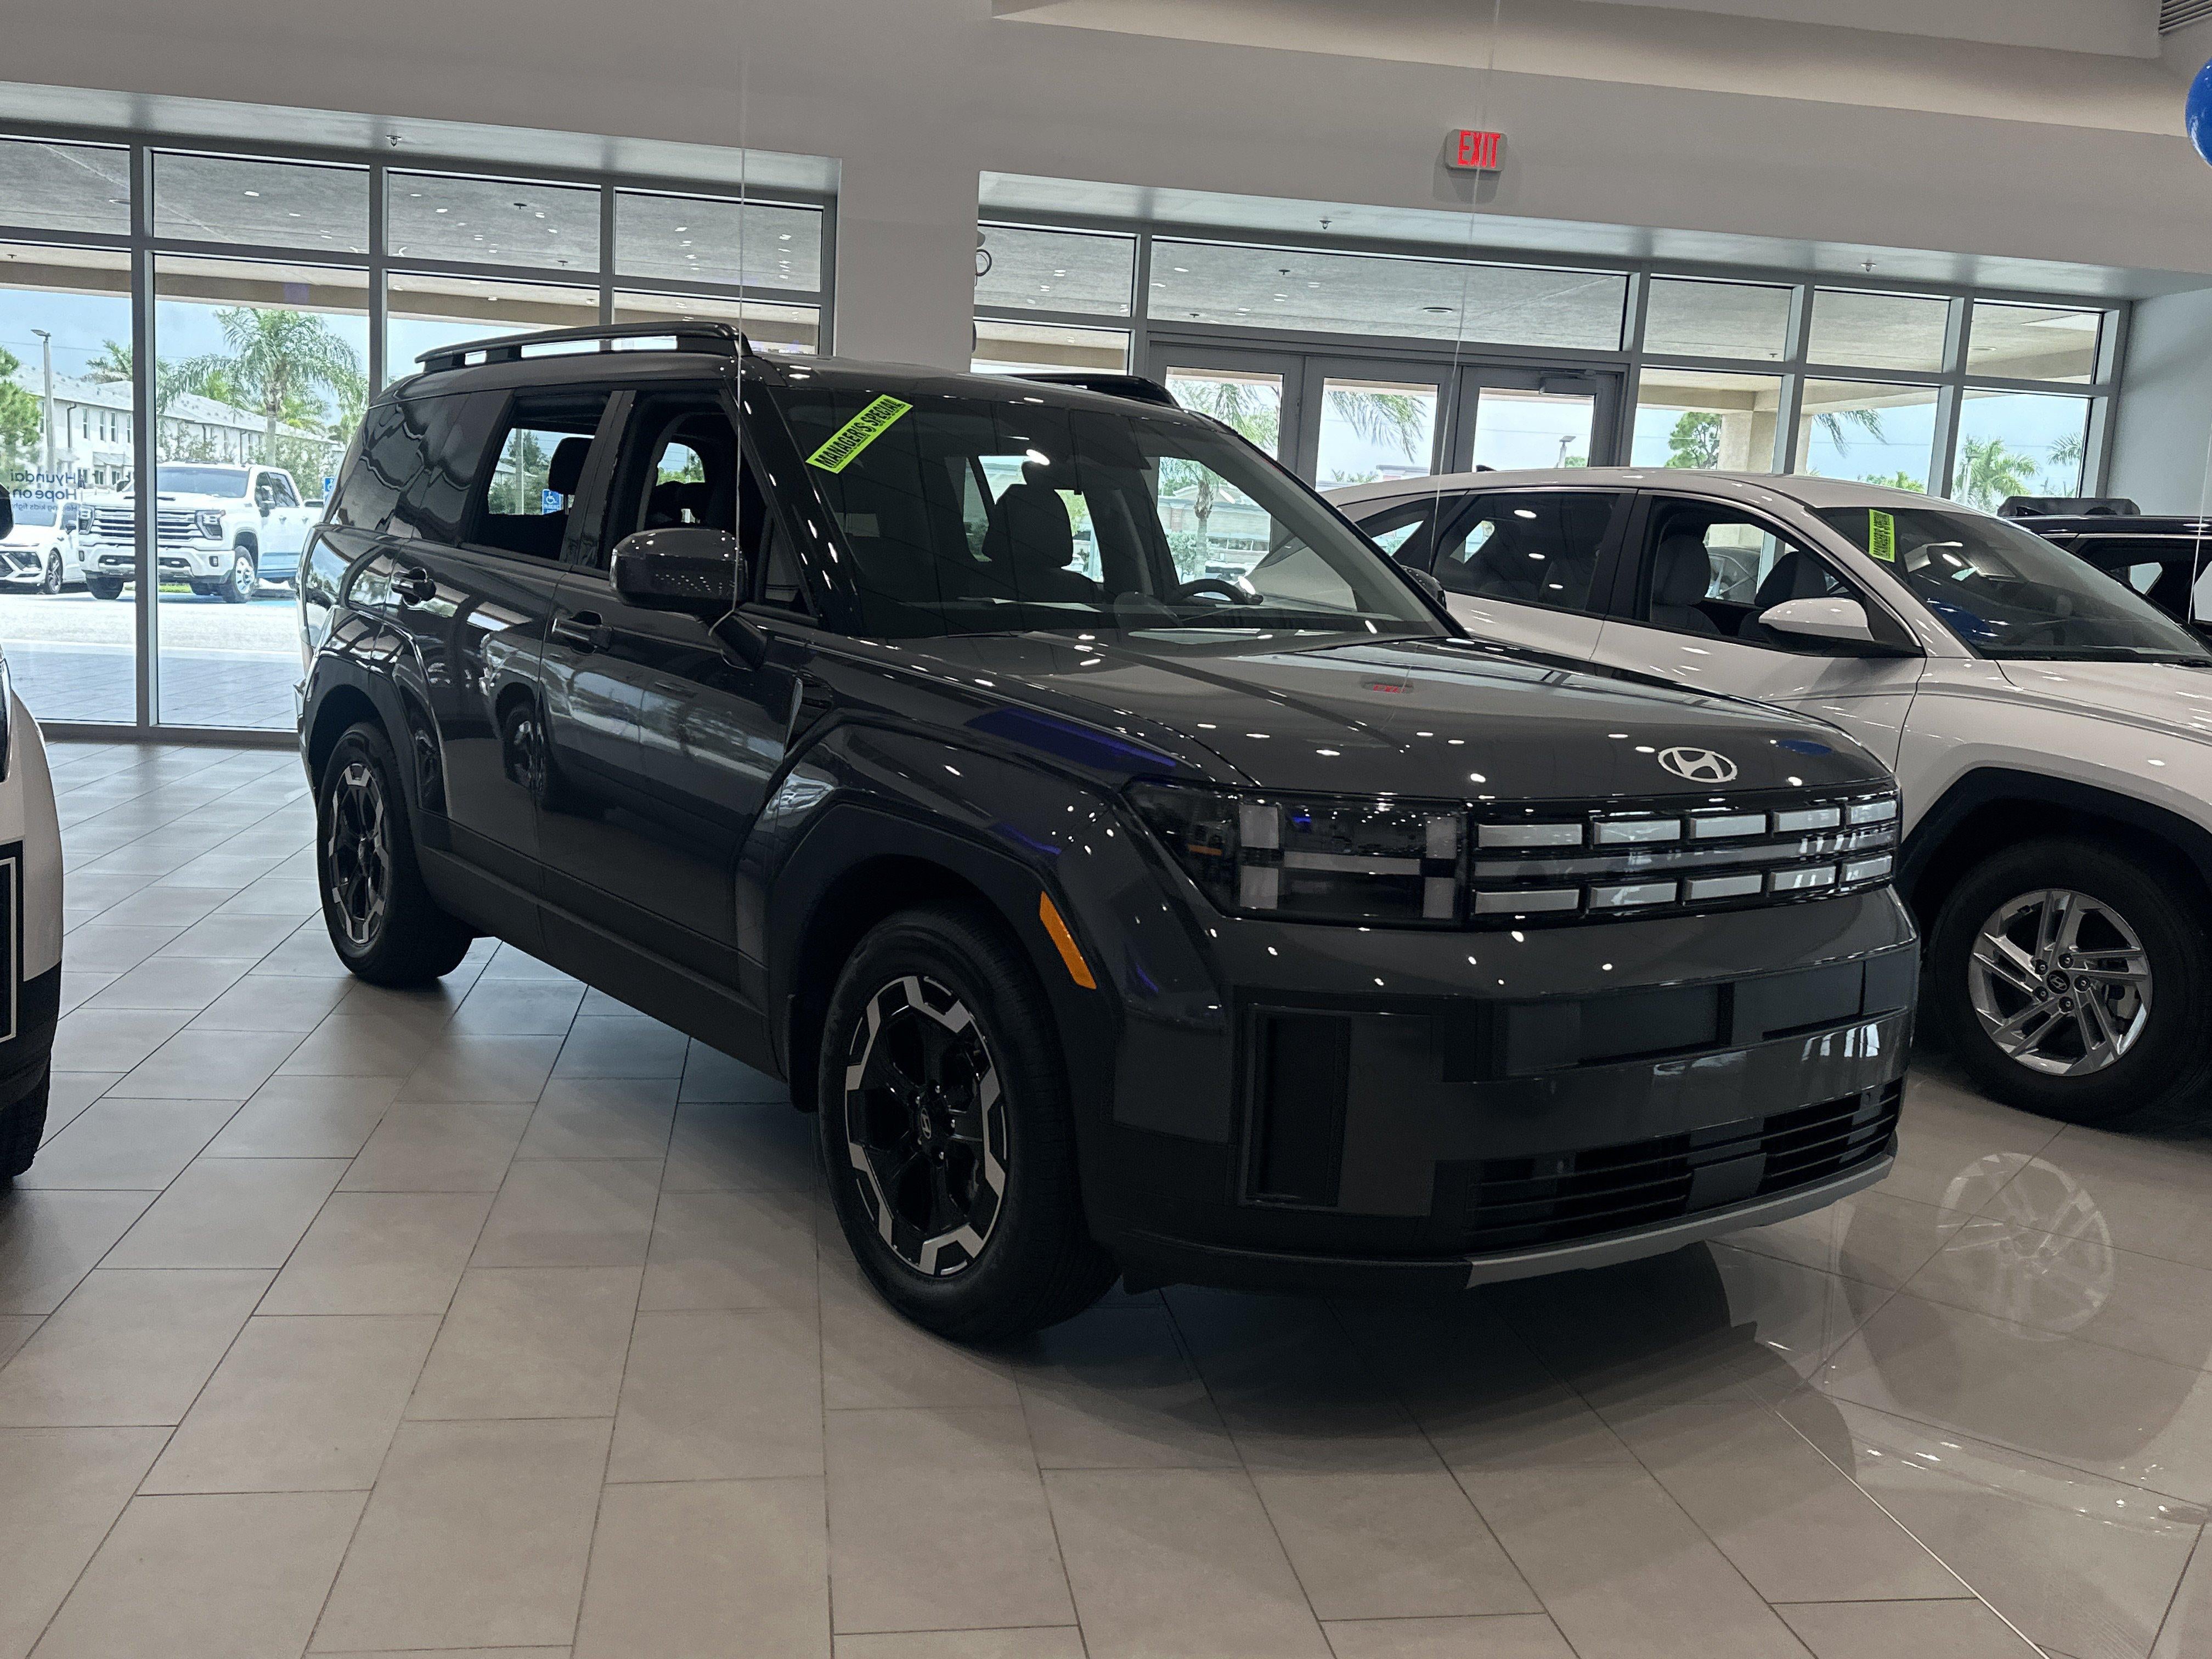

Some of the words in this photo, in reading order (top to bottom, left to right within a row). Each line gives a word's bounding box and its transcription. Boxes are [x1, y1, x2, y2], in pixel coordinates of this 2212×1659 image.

[1457, 129, 1502, 168] EXIT
[814, 422, 877, 469] MANAGER'S
[860, 398, 906, 427] SPECIAL
